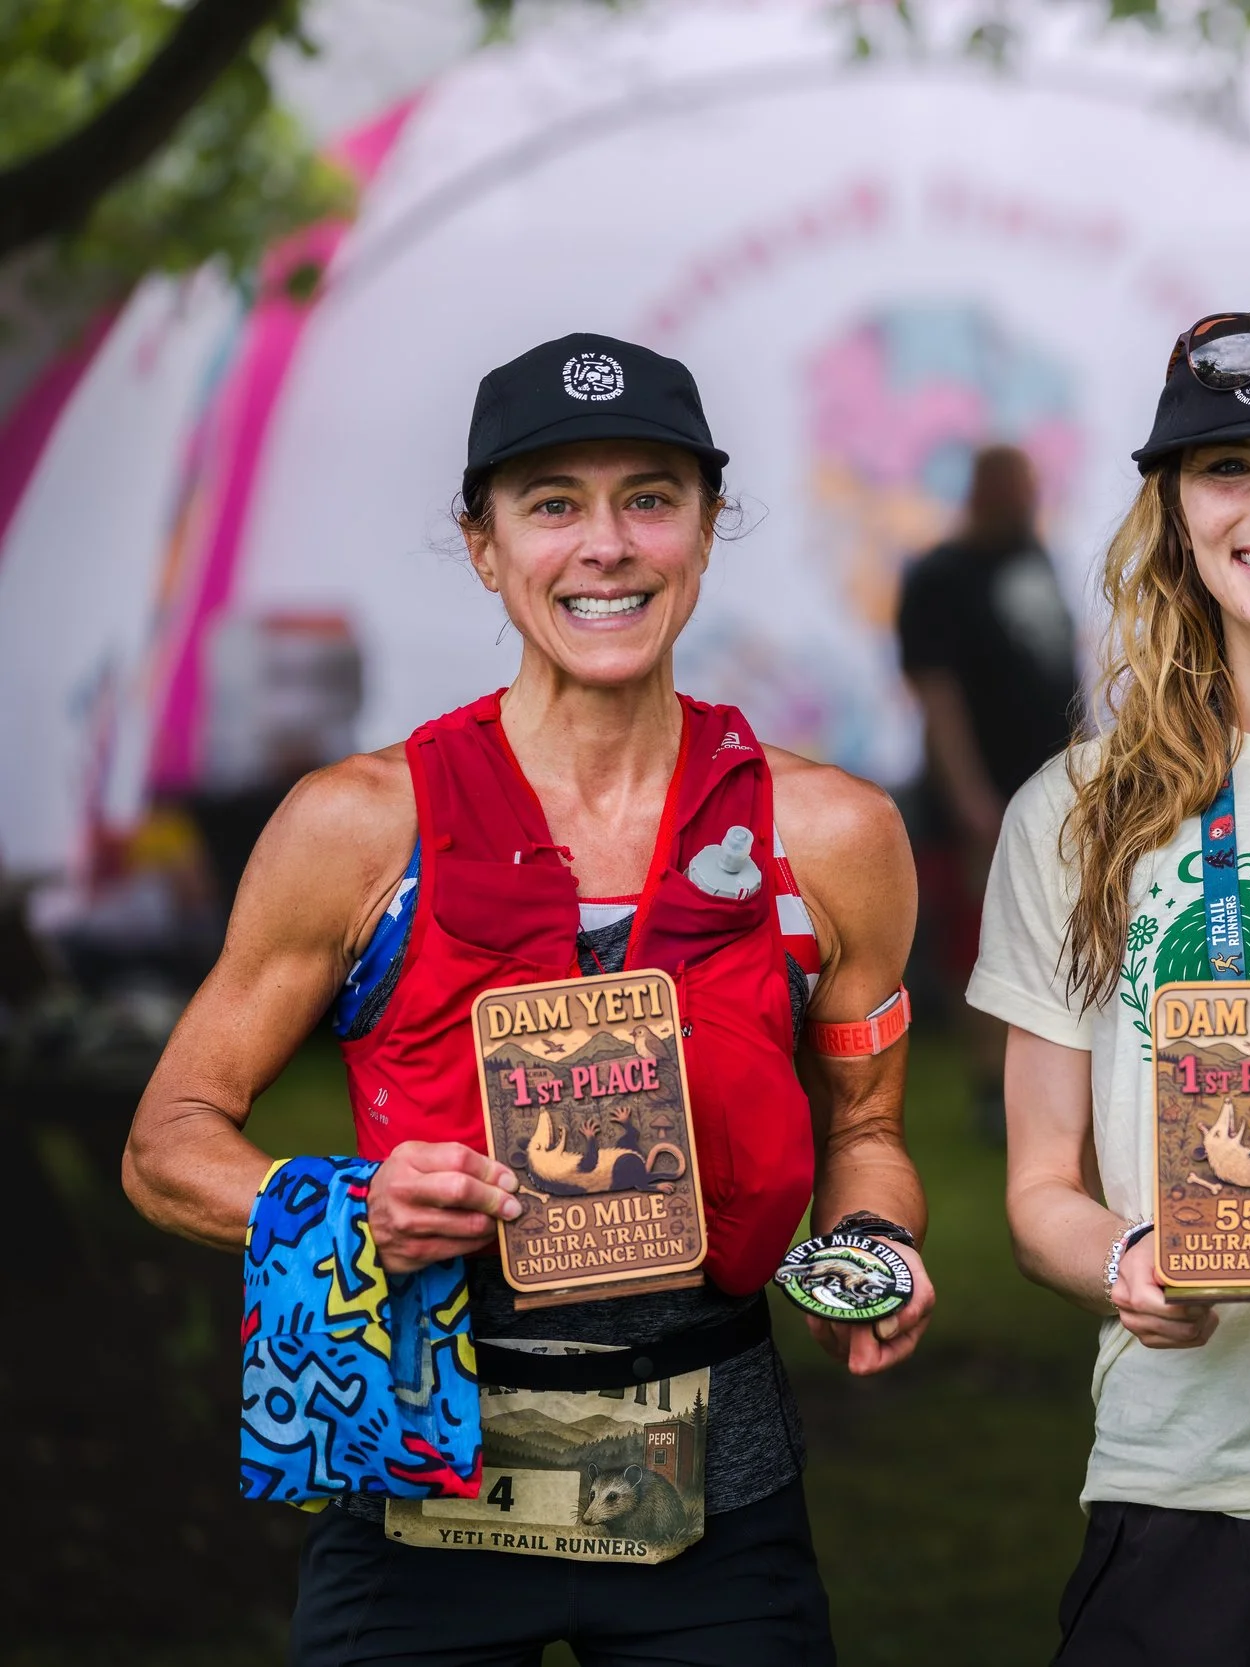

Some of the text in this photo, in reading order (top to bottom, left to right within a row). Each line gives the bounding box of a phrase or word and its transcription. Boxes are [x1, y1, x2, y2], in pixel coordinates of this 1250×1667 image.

[562, 357, 578, 375] BURY
[600, 354, 623, 374] BONES
[564, 383, 588, 401] VIRGINIA
[590, 388, 624, 401] CREEPER
[1210, 898, 1227, 946] TRAIL
[1226, 894, 1240, 947] RUNNERS
[486, 983, 664, 1040] DAM YETI
[1164, 998, 1248, 1039] DAM
[508, 1058, 660, 1107] 1ST PLACE
[1178, 1054, 1235, 1095] 1ST
[547, 1194, 668, 1234] 50 MILE
[516, 1238, 684, 1277] ENDURANCE RUN
[526, 1222, 667, 1257] ULTRA TRAIL
[785, 1235, 912, 1294] FIFTY MILE FINISHER
[800, 1295, 880, 1317] APPALACHIA
[648, 1432, 675, 1446] PEPSI
[487, 1475, 515, 1512] 4
[438, 1528, 649, 1557] YETI TRAIL RUNNERS
